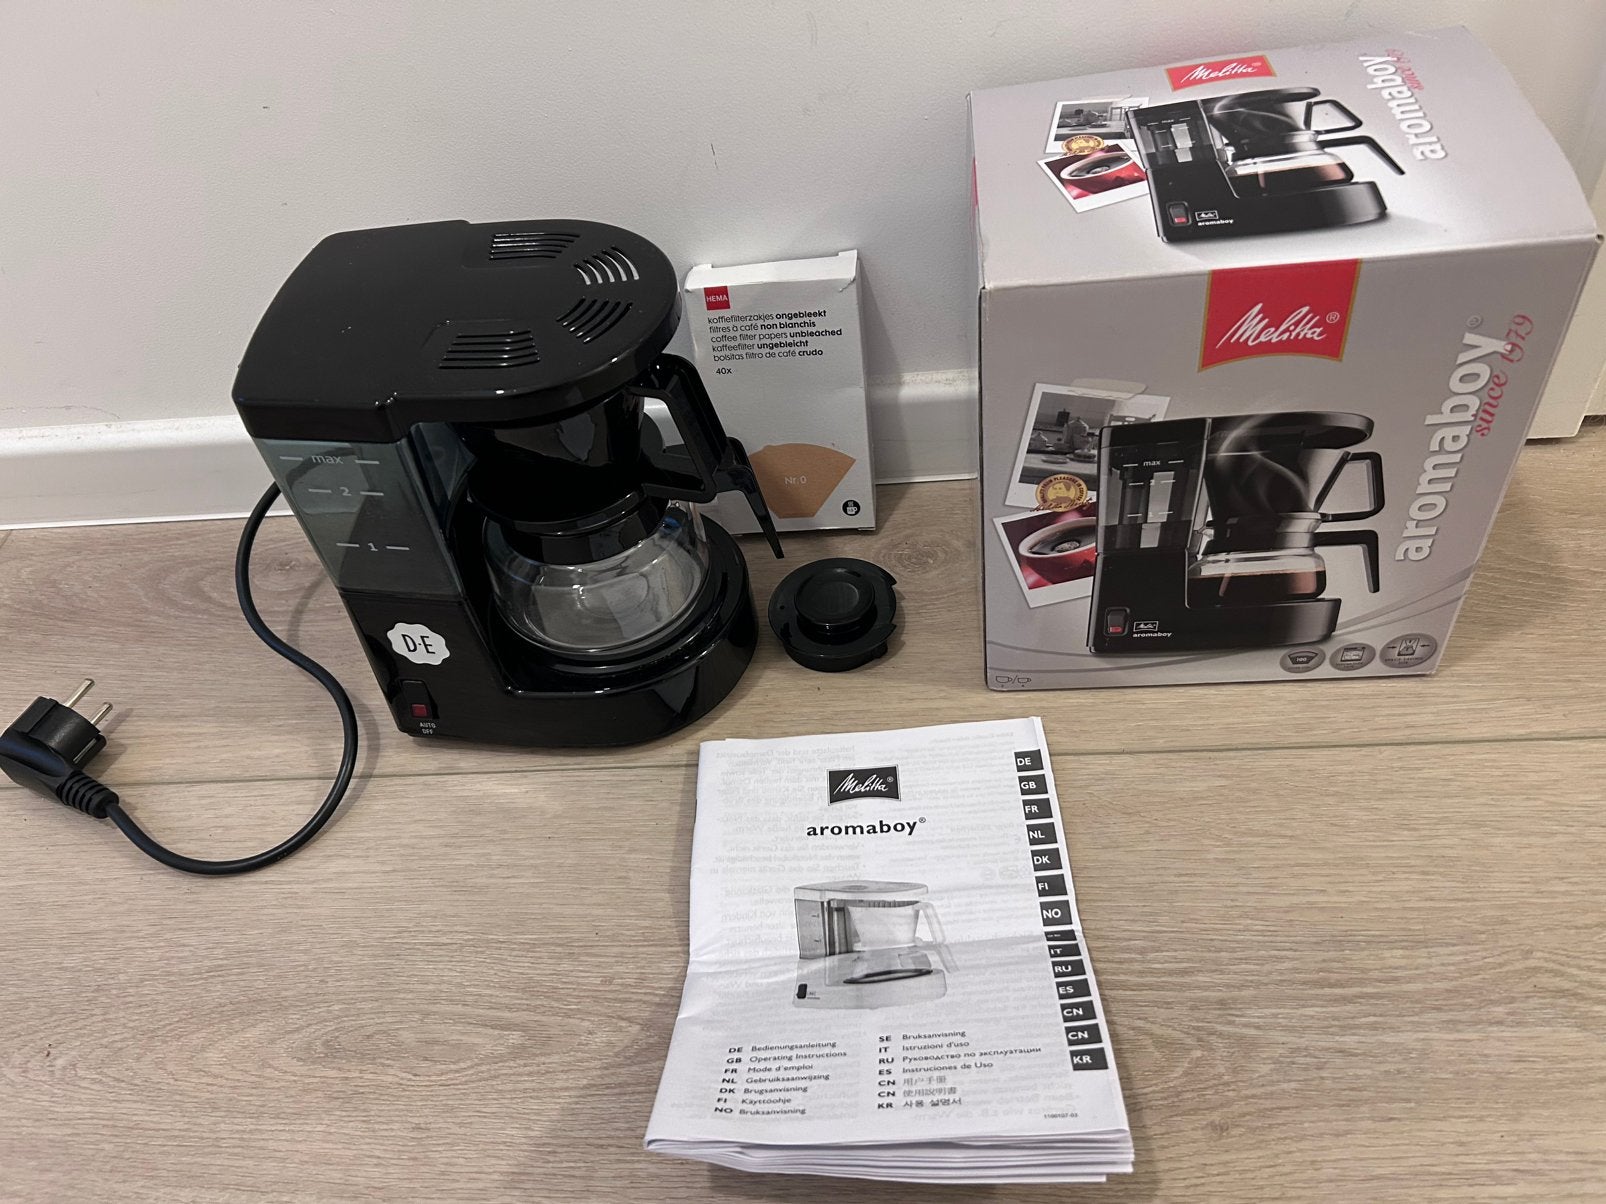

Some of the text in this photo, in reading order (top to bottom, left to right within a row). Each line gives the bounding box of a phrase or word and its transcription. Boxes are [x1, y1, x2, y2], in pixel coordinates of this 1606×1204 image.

[706, 294, 729, 302] HEMA
[707, 309, 827, 324] koffiefilterzakjes ongebleekt
[709, 325, 731, 334] filtres
[740, 323, 759, 332] café
[760, 322, 778, 331] non
[780, 320, 816, 329] blanchis
[711, 328, 842, 343] coffee filter papers unbleached
[712, 339, 809, 352] kaffeefilter ungebleicht
[713, 348, 823, 362] bolsitas filtro de café crudo
[715, 367, 732, 375] 40x
[1475, 314, 1535, 438] since 1979
[311, 454, 345, 464] max
[340, 486, 352, 496] 2
[367, 542, 378, 551] 1
[1016, 757, 1032, 766] DE
[1020, 781, 1037, 790] GB
[1025, 805, 1039, 813] FR
[1029, 830, 1045, 839] NL
[1033, 856, 1051, 865] DK
[1038, 882, 1049, 891] FI
[1042, 908, 1061, 919] NO
[1054, 965, 1072, 973] RU
[1058, 986, 1075, 994] ES
[1063, 1008, 1084, 1017] CN
[902, 1030, 966, 1040] Bruksanvisning
[1068, 1031, 1089, 1040] CN
[728, 1041, 837, 1054] DE Bedienungsanleitung
[902, 1043, 944, 1052] Istruzioni
[749, 1054, 793, 1064] Operating
[795, 1051, 847, 1060] Instructions
[902, 1053, 961, 1063] Руководство
[979, 1047, 1042, 1057] эксплуатации
[1073, 1055, 1093, 1064] KR
[747, 1066, 773, 1074] Mode
[878, 1061, 994, 1076] ES Instruciones de Uso
[745, 1074, 830, 1084] Gebruiksaanwijzing
[743, 1086, 808, 1095] Brugsanvisning
[739, 1107, 807, 1116] Bruksanvisning
